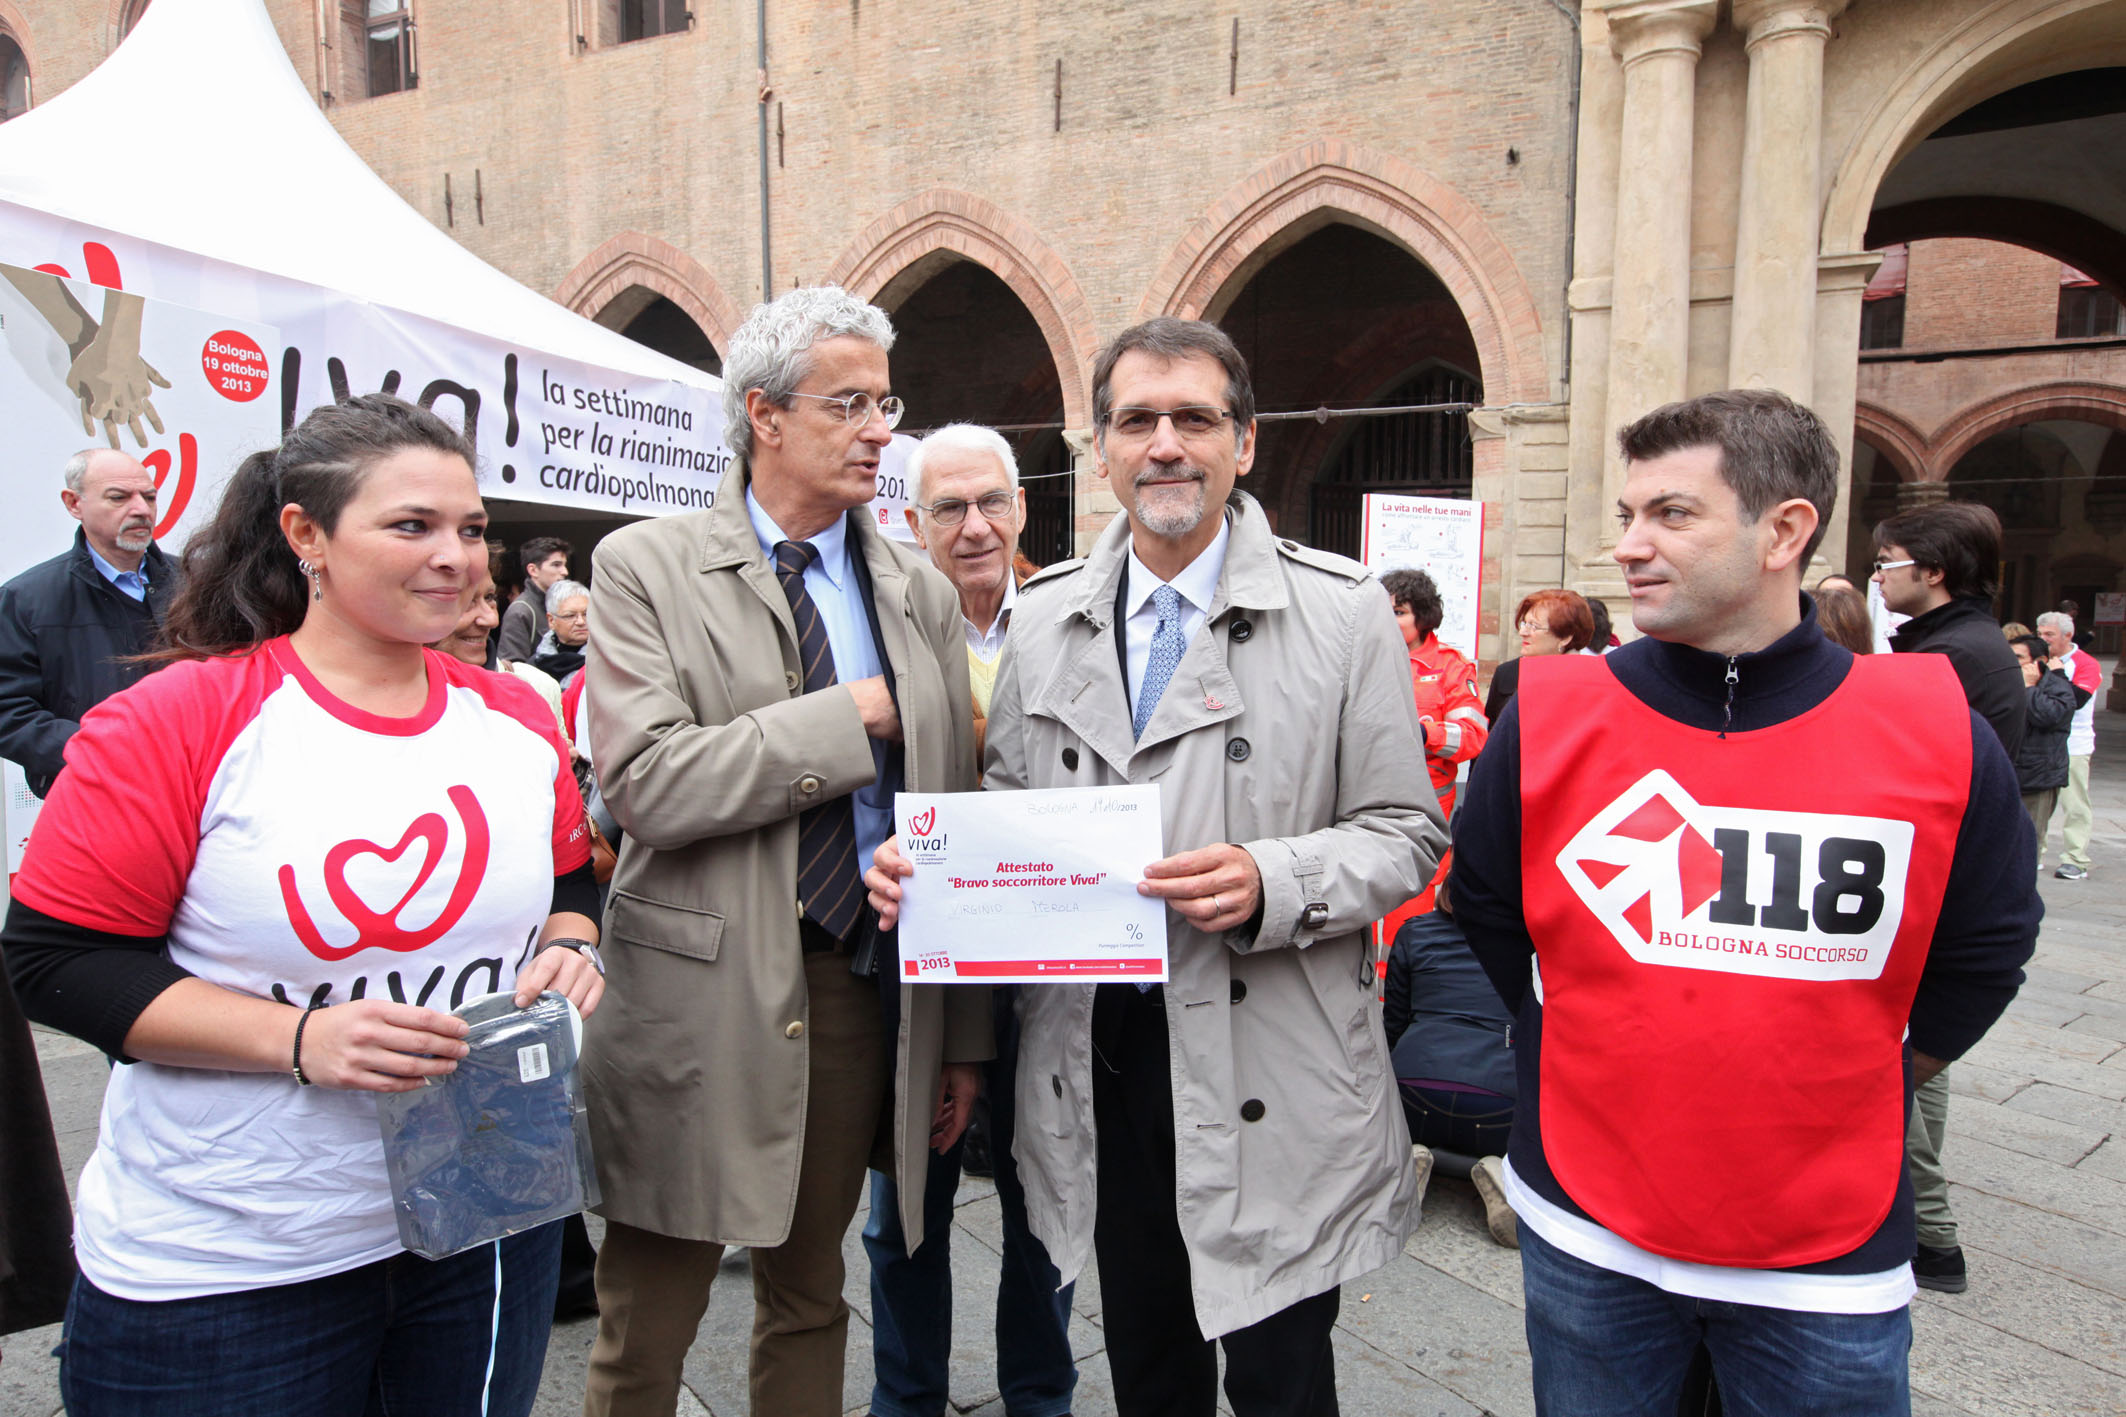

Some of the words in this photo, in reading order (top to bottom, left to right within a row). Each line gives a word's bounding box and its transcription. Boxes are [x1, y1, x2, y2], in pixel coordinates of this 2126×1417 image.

[209, 340, 262, 361] Bologna
[204, 357, 219, 370] 19
[222, 362, 268, 379] ottobre
[222, 377, 252, 392] 2013
[542, 369, 566, 405] la
[573, 388, 692, 431] settimana
[541, 422, 585, 454] per
[591, 422, 613, 456] la
[876, 475, 909, 501] 201
[1382, 502, 1392, 511] La
[1394, 503, 1410, 513] vita
[1412, 504, 1432, 514] nelle
[1435, 506, 1448, 516] tue
[1450, 507, 1471, 517] mani
[908, 833, 947, 851] viva!
[996, 861, 1054, 873] Attestato
[992, 875, 1067, 887] soccorritore
[1709, 828, 1885, 934] 118
[1126, 923, 1143, 940] %
[1658, 931, 1769, 957] BOLOGNA
[1776, 944, 1868, 962] SOCCORSO
[920, 957, 950, 970] 2013
